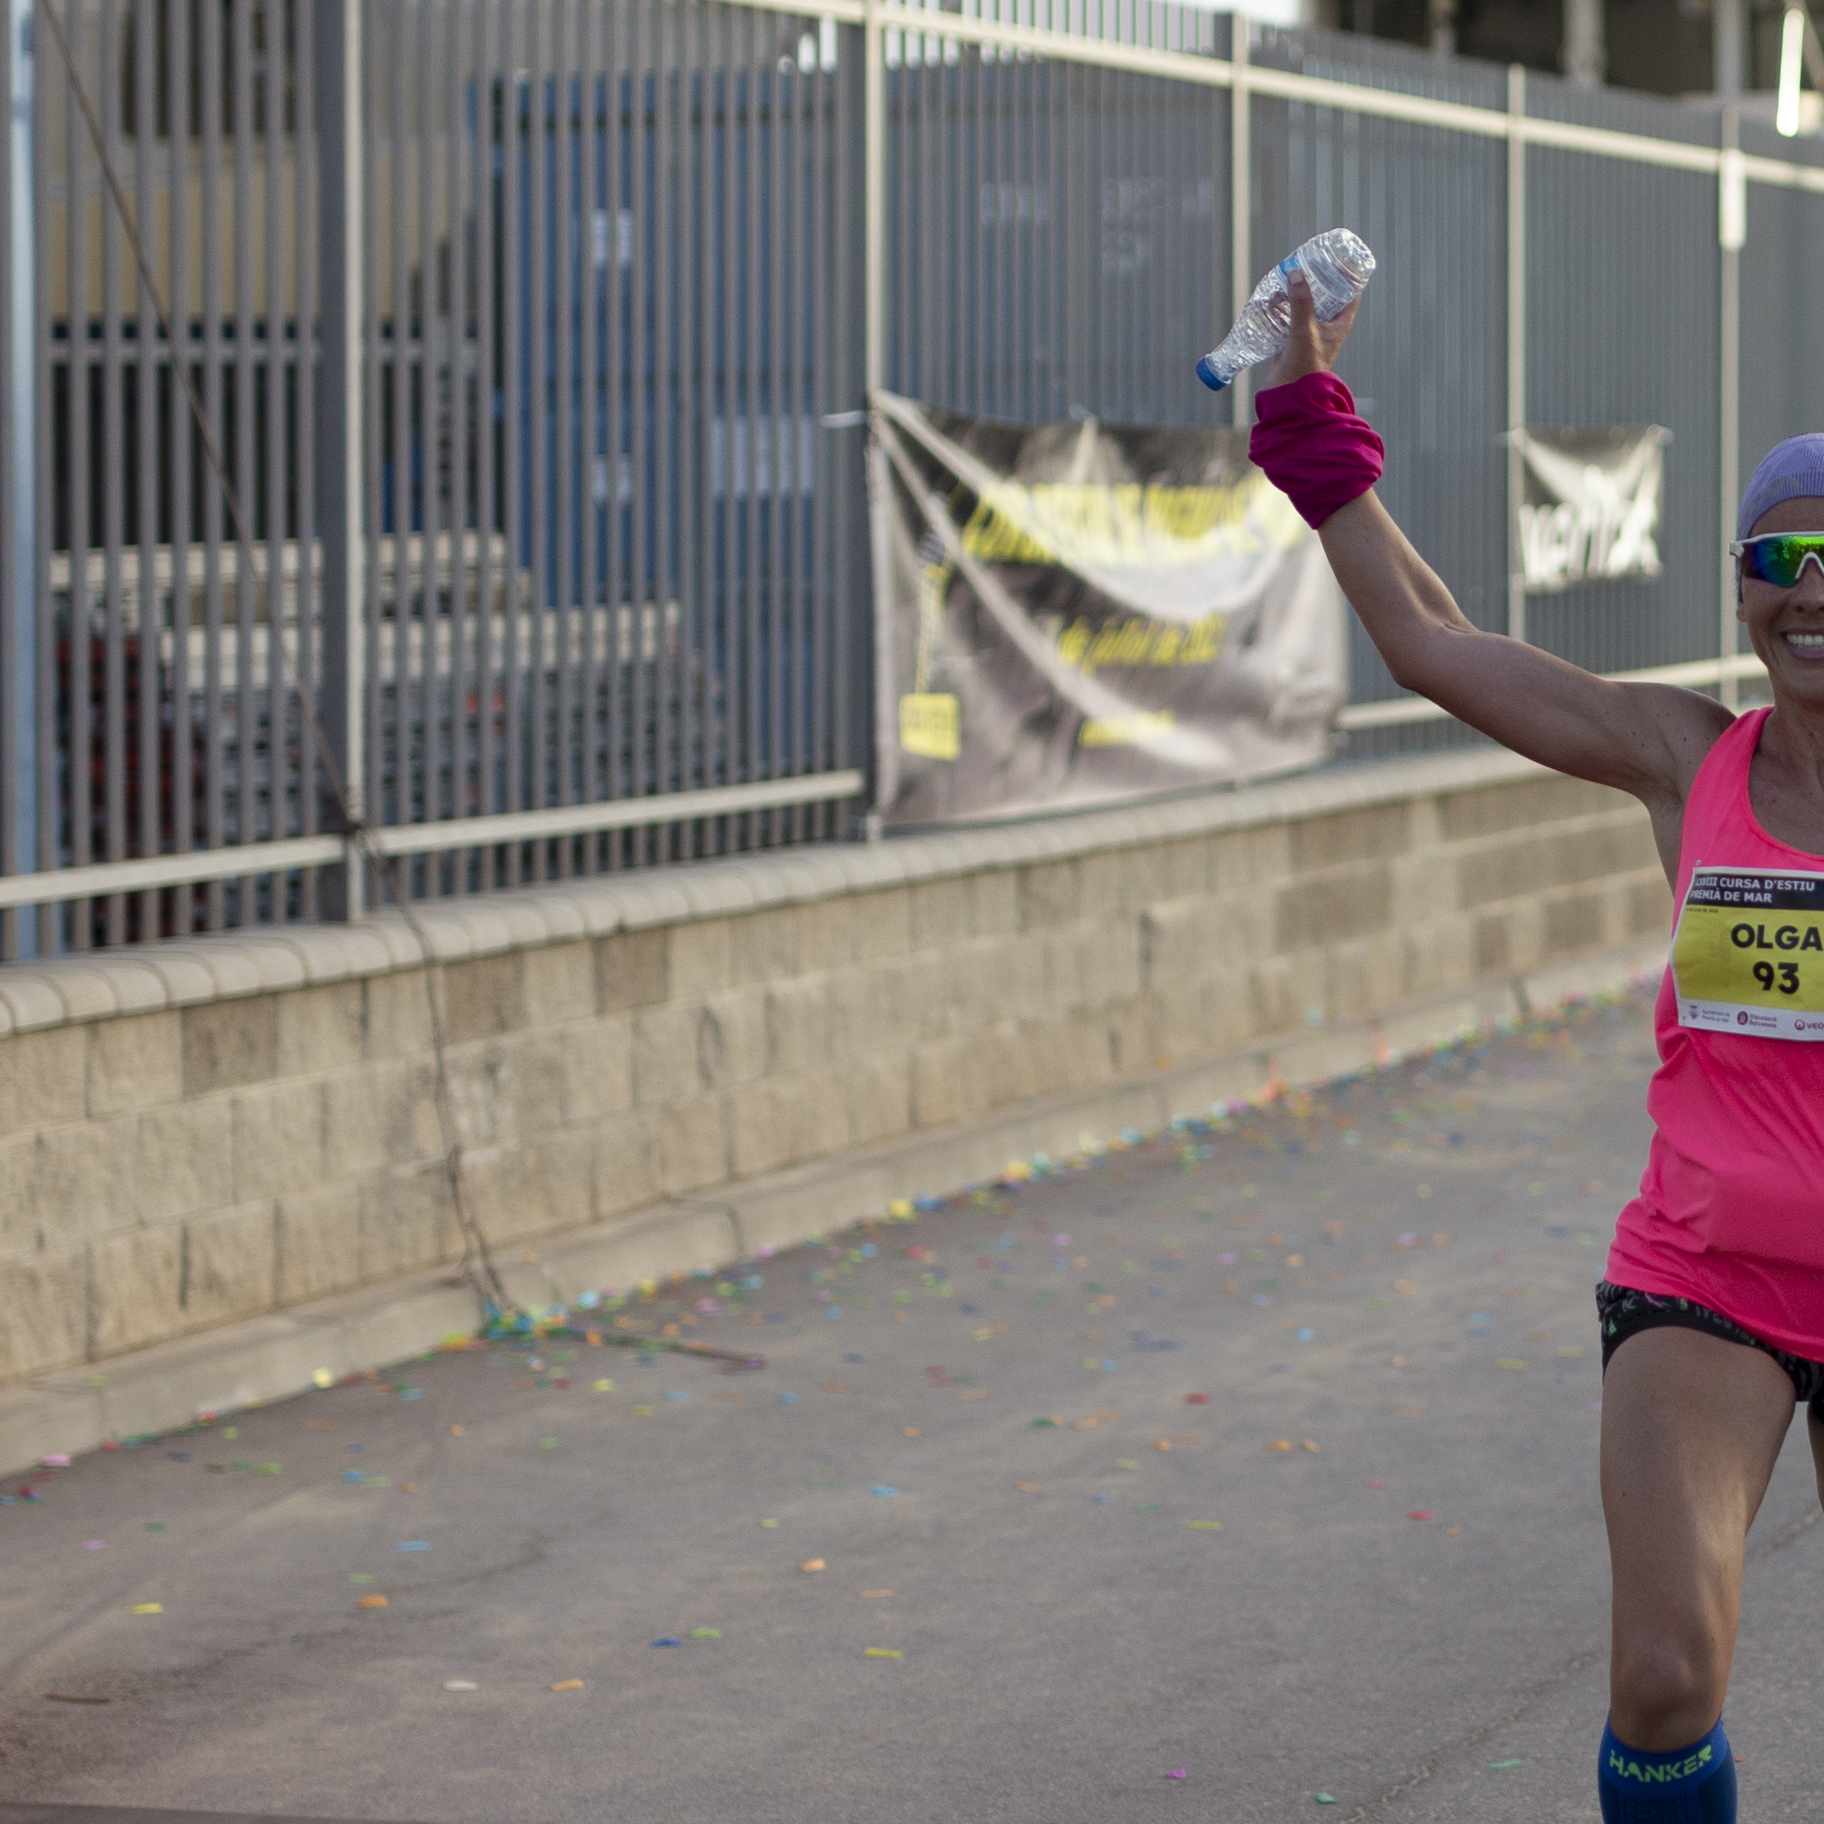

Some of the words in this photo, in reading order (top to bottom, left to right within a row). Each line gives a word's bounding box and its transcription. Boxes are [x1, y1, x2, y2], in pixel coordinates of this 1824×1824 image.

[1690, 887, 1720, 901] PREMIÀ
[1723, 890, 1740, 902] DE
[1744, 892, 1772, 903] MAR
[1720, 877, 1761, 889] CURSA
[1764, 879, 1815, 891] D'ESTIU
[1731, 923, 1824, 951] OLGA
[1752, 960, 1800, 994] 93
